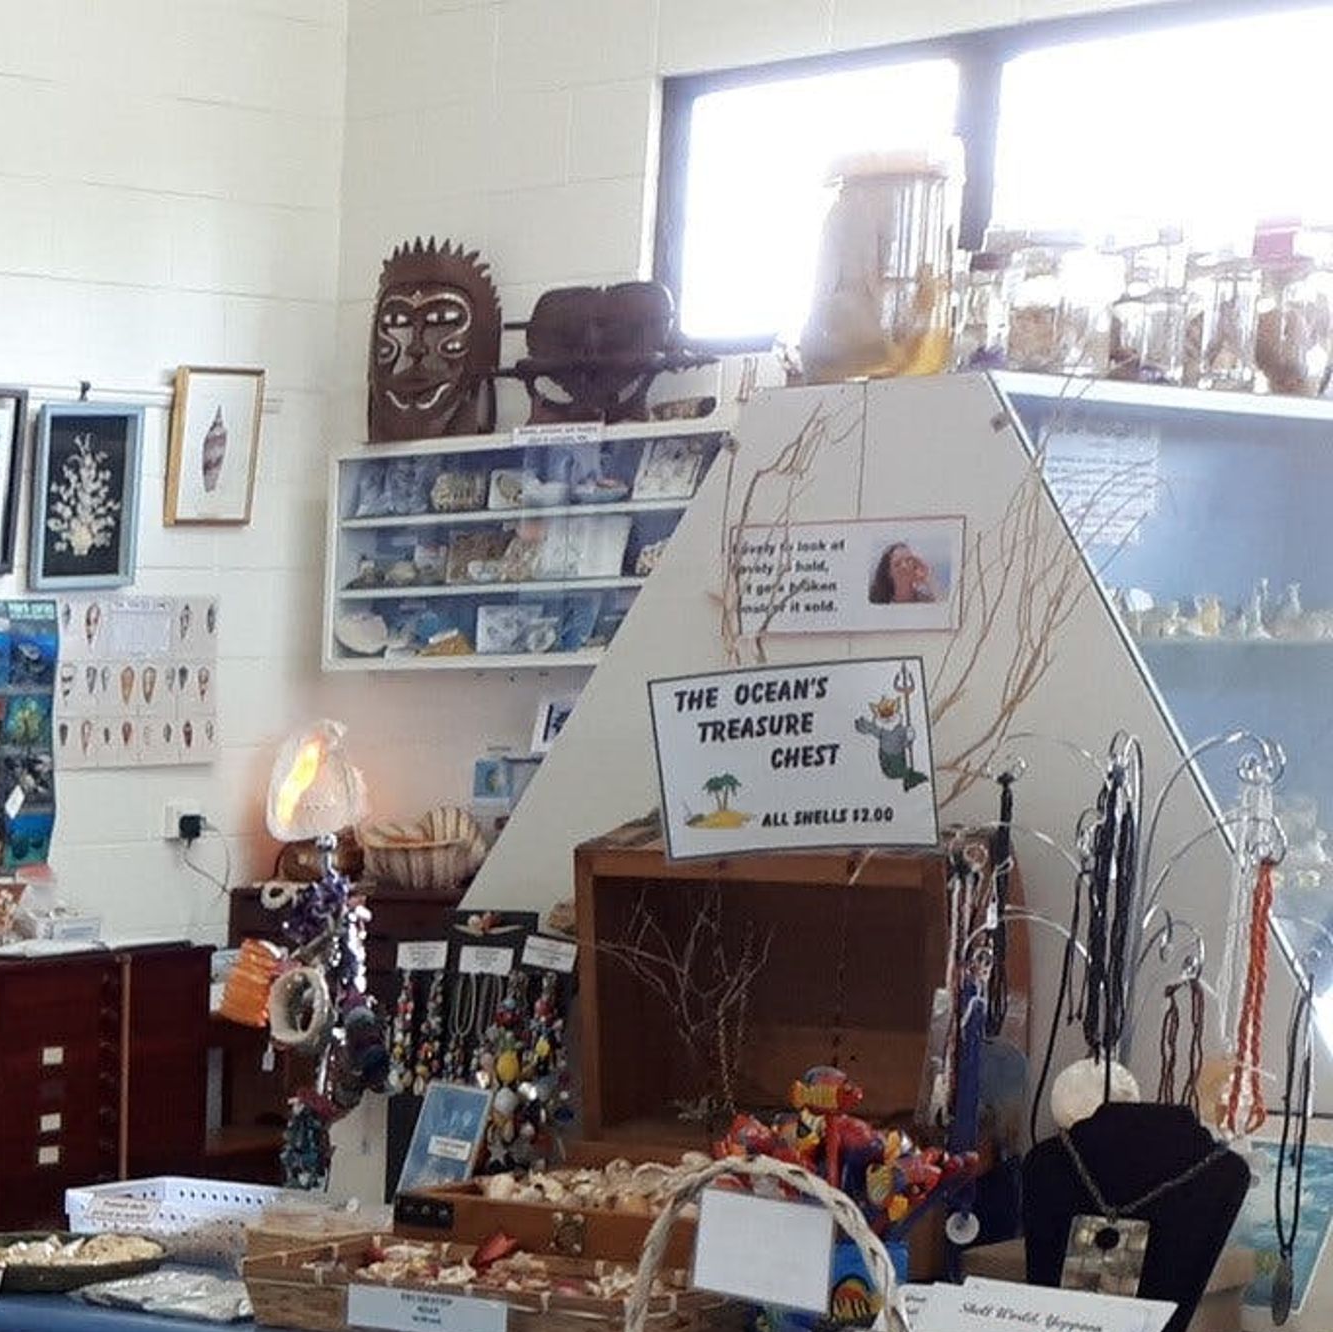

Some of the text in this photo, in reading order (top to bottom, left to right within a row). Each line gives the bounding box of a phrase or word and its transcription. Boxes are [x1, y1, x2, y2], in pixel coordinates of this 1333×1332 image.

[797, 540, 825, 552] look
[830, 539, 845, 551] at
[734, 562, 773, 576] ovely
[790, 601, 800, 612] it
[674, 677, 829, 712] THE OCEAN'S
[697, 712, 814, 743] TREASURE
[770, 744, 840, 770] CHEST
[761, 806, 894, 827] ALL SHELLS $2.00
[959, 1302, 993, 1318] Shell
